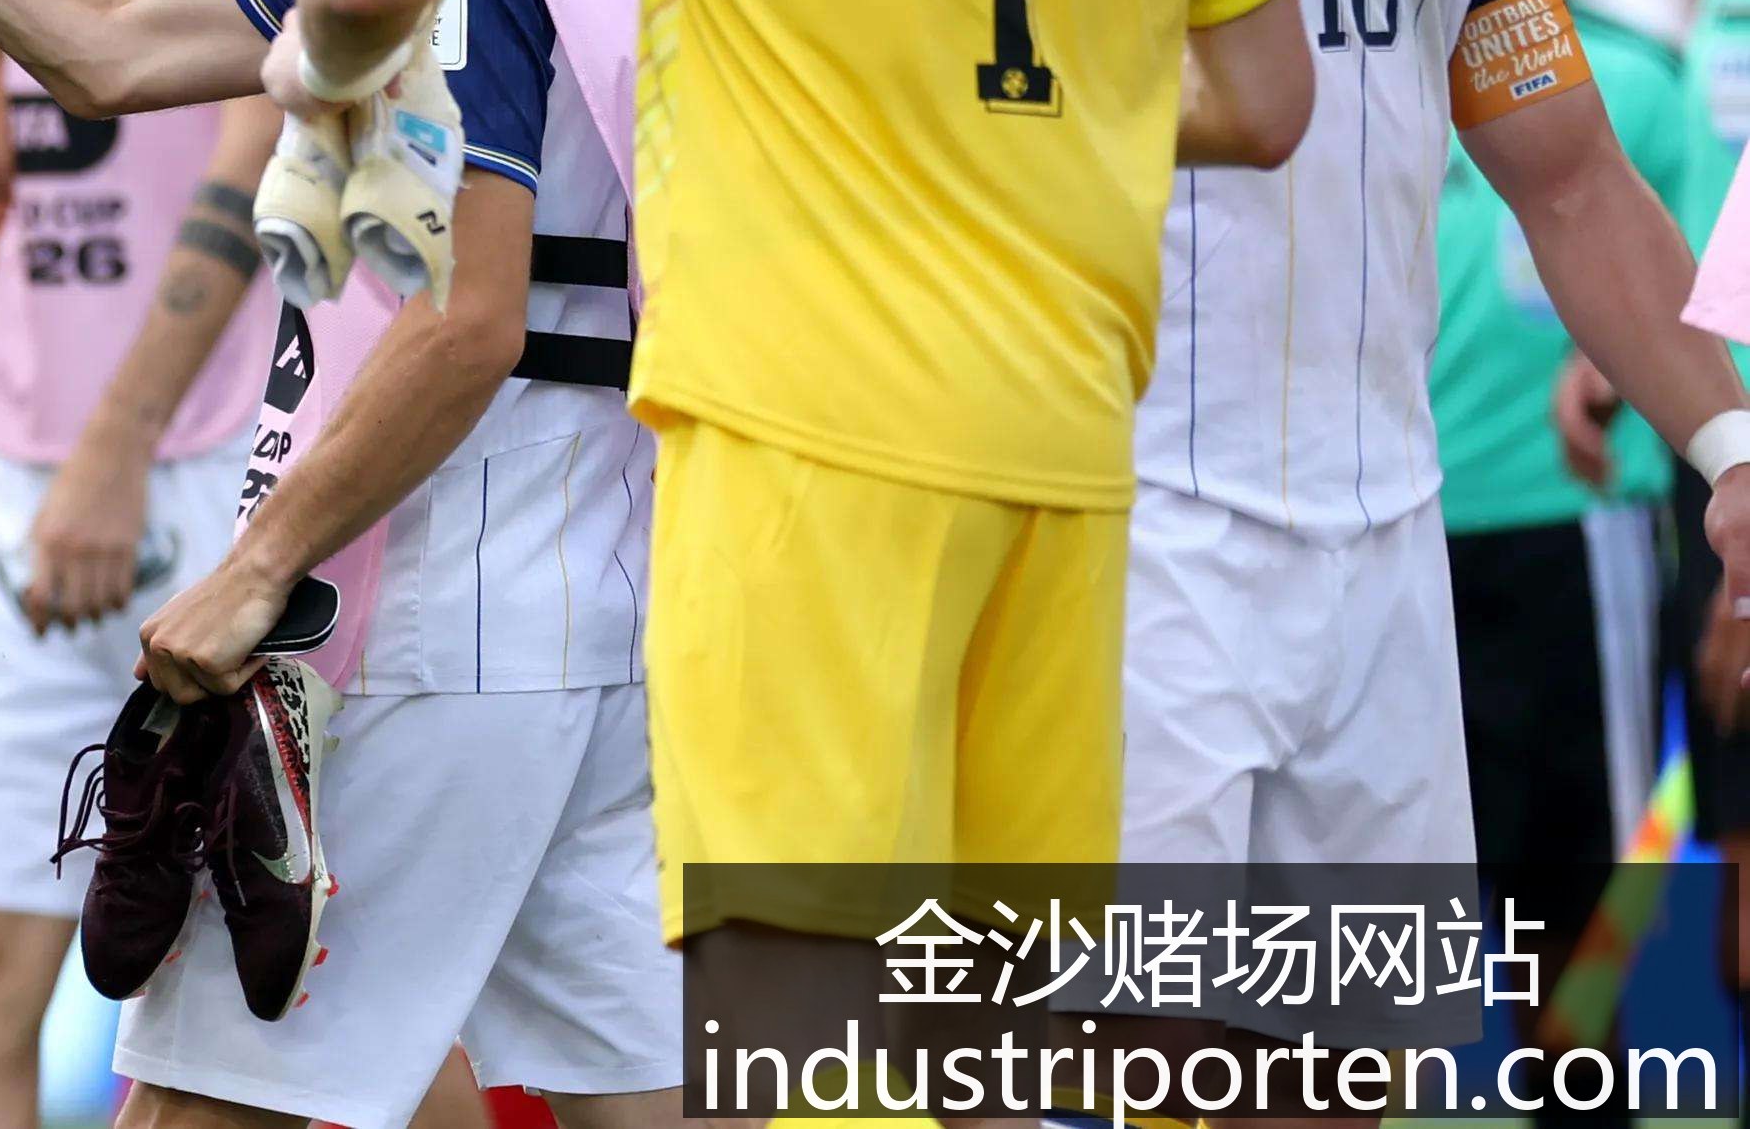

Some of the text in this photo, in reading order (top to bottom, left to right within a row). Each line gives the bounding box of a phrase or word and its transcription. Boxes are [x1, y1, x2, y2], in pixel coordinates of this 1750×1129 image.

[1460, 11, 1561, 68] UNITES
[1511, 33, 1574, 77] World
[1512, 73, 1556, 97] FIFA
[25, 237, 129, 286] 26
